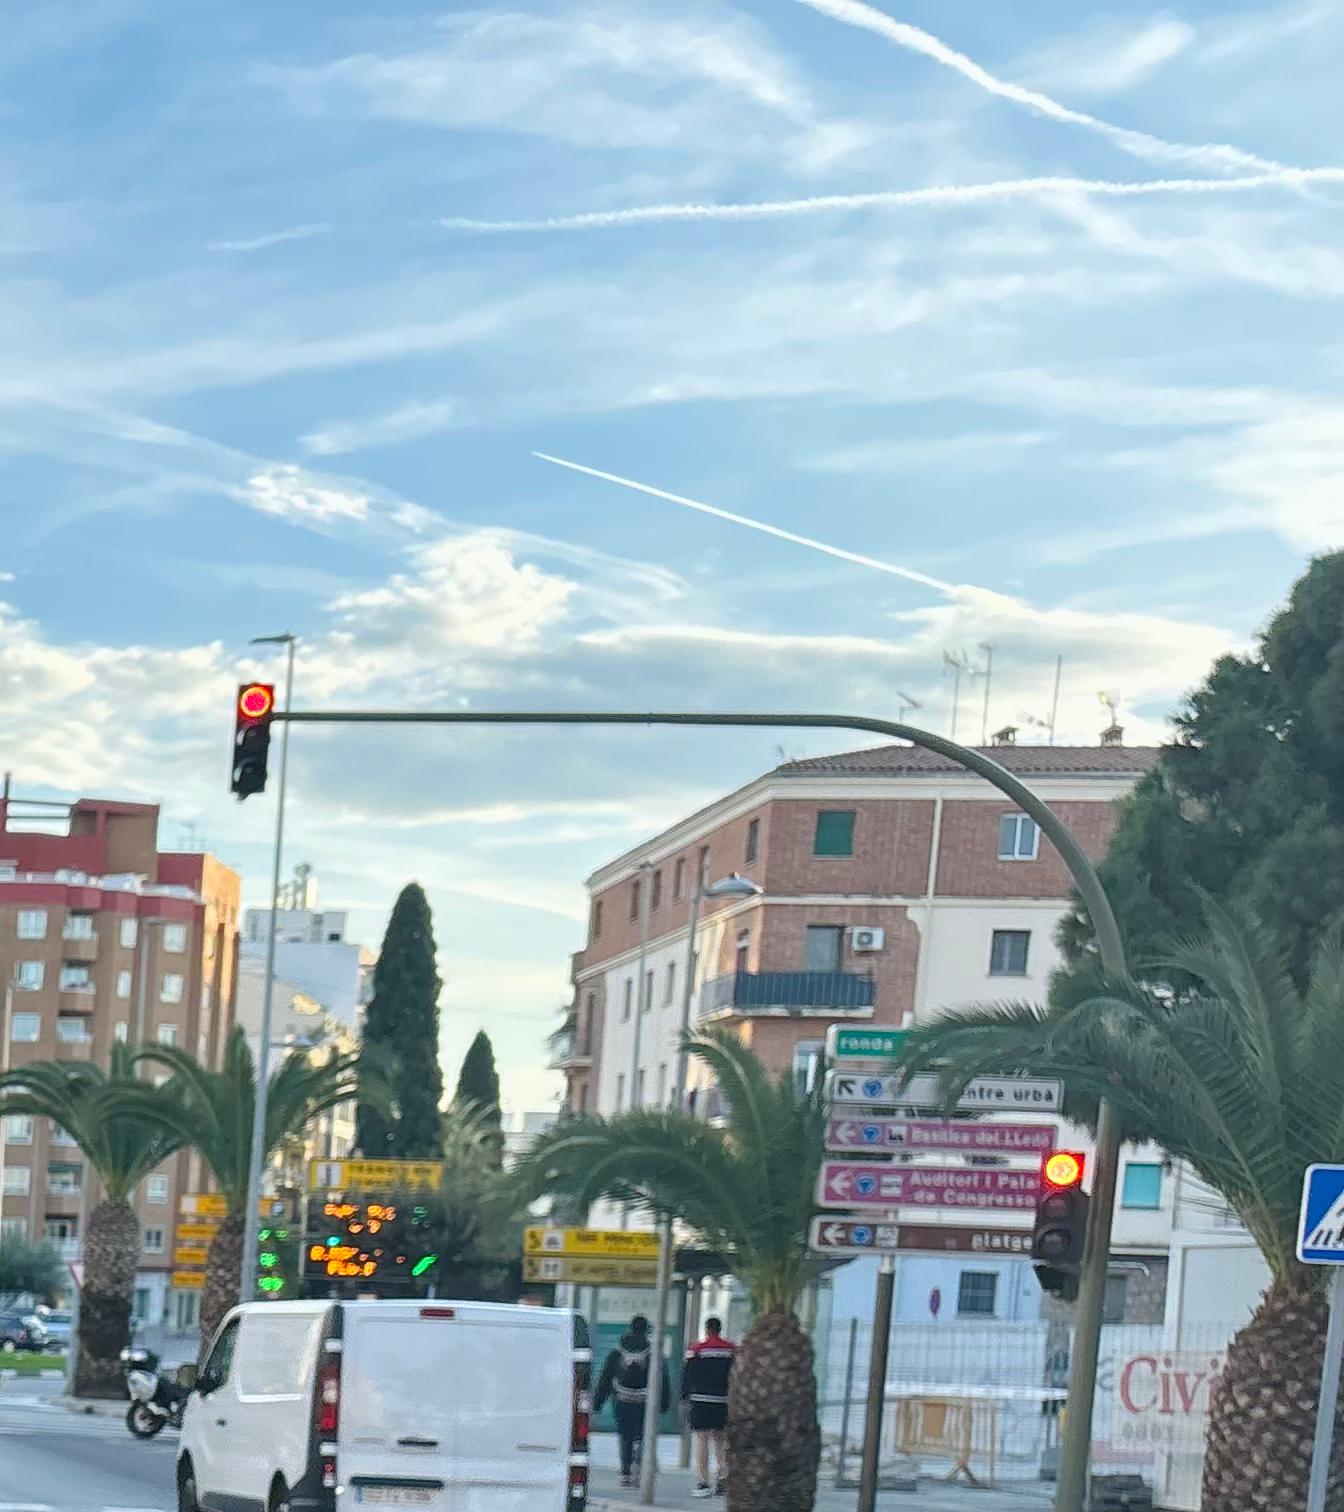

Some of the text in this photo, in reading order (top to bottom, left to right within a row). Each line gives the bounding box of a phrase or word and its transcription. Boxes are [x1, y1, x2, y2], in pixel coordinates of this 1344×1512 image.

[997, 1174, 1039, 1190] Pala
[944, 1189, 1037, 1208] Congresso
[971, 1232, 1034, 1252] platge
[1120, 1354, 1225, 1416] Civi
